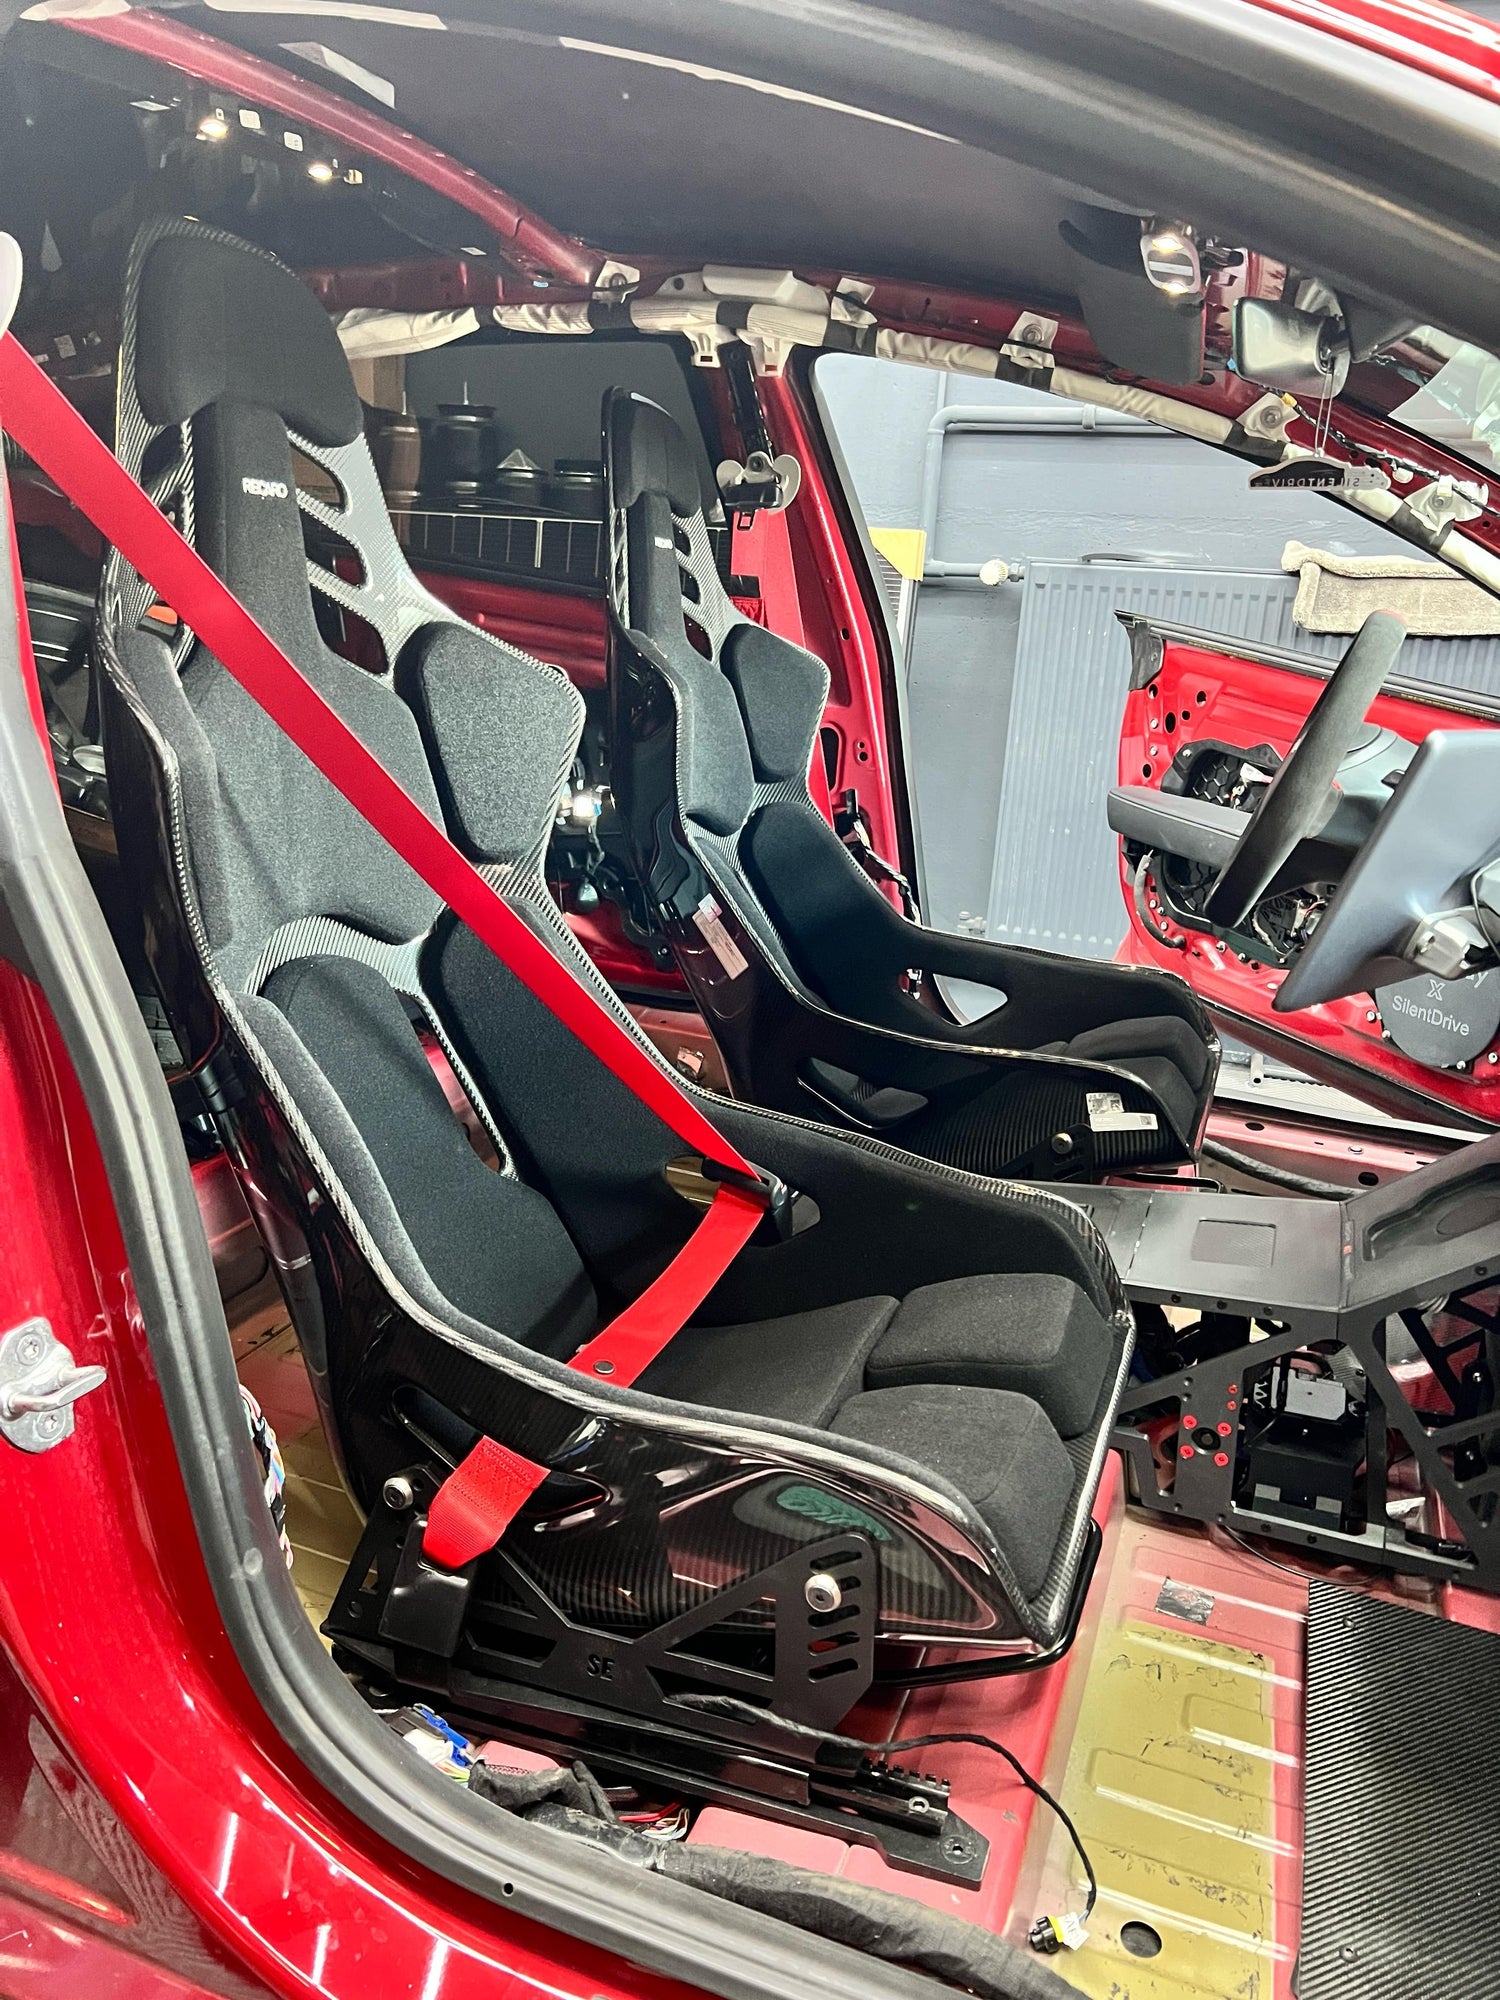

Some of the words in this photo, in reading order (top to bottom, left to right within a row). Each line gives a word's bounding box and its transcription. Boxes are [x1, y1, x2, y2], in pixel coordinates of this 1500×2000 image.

[242, 477, 288, 499] RECARO
[1392, 995, 1470, 1036] SilentDrive
[586, 1653, 615, 1681] SE
